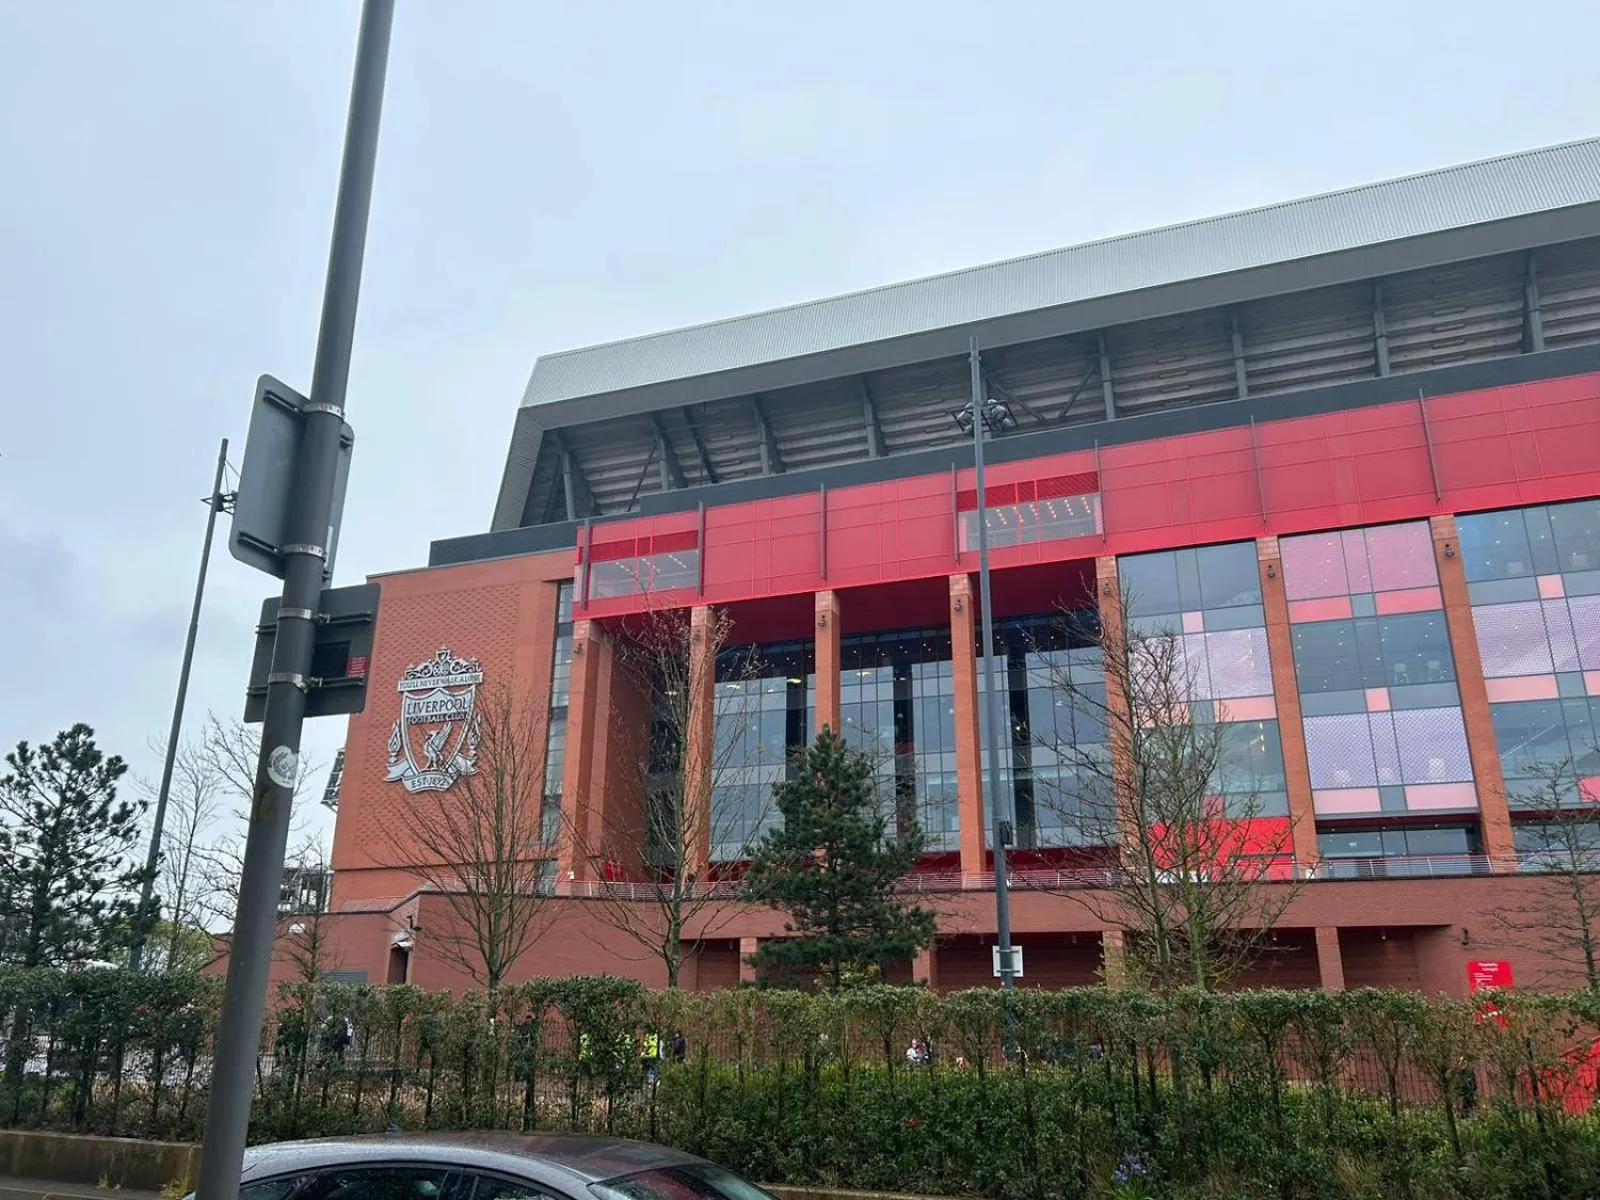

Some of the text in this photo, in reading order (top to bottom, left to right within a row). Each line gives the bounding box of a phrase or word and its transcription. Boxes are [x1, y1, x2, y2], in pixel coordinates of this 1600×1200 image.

[419, 678, 439, 687] NEVER
[407, 697, 468, 715] LIVERPOOL
[407, 712, 465, 723] FOOTBALL CLUB
